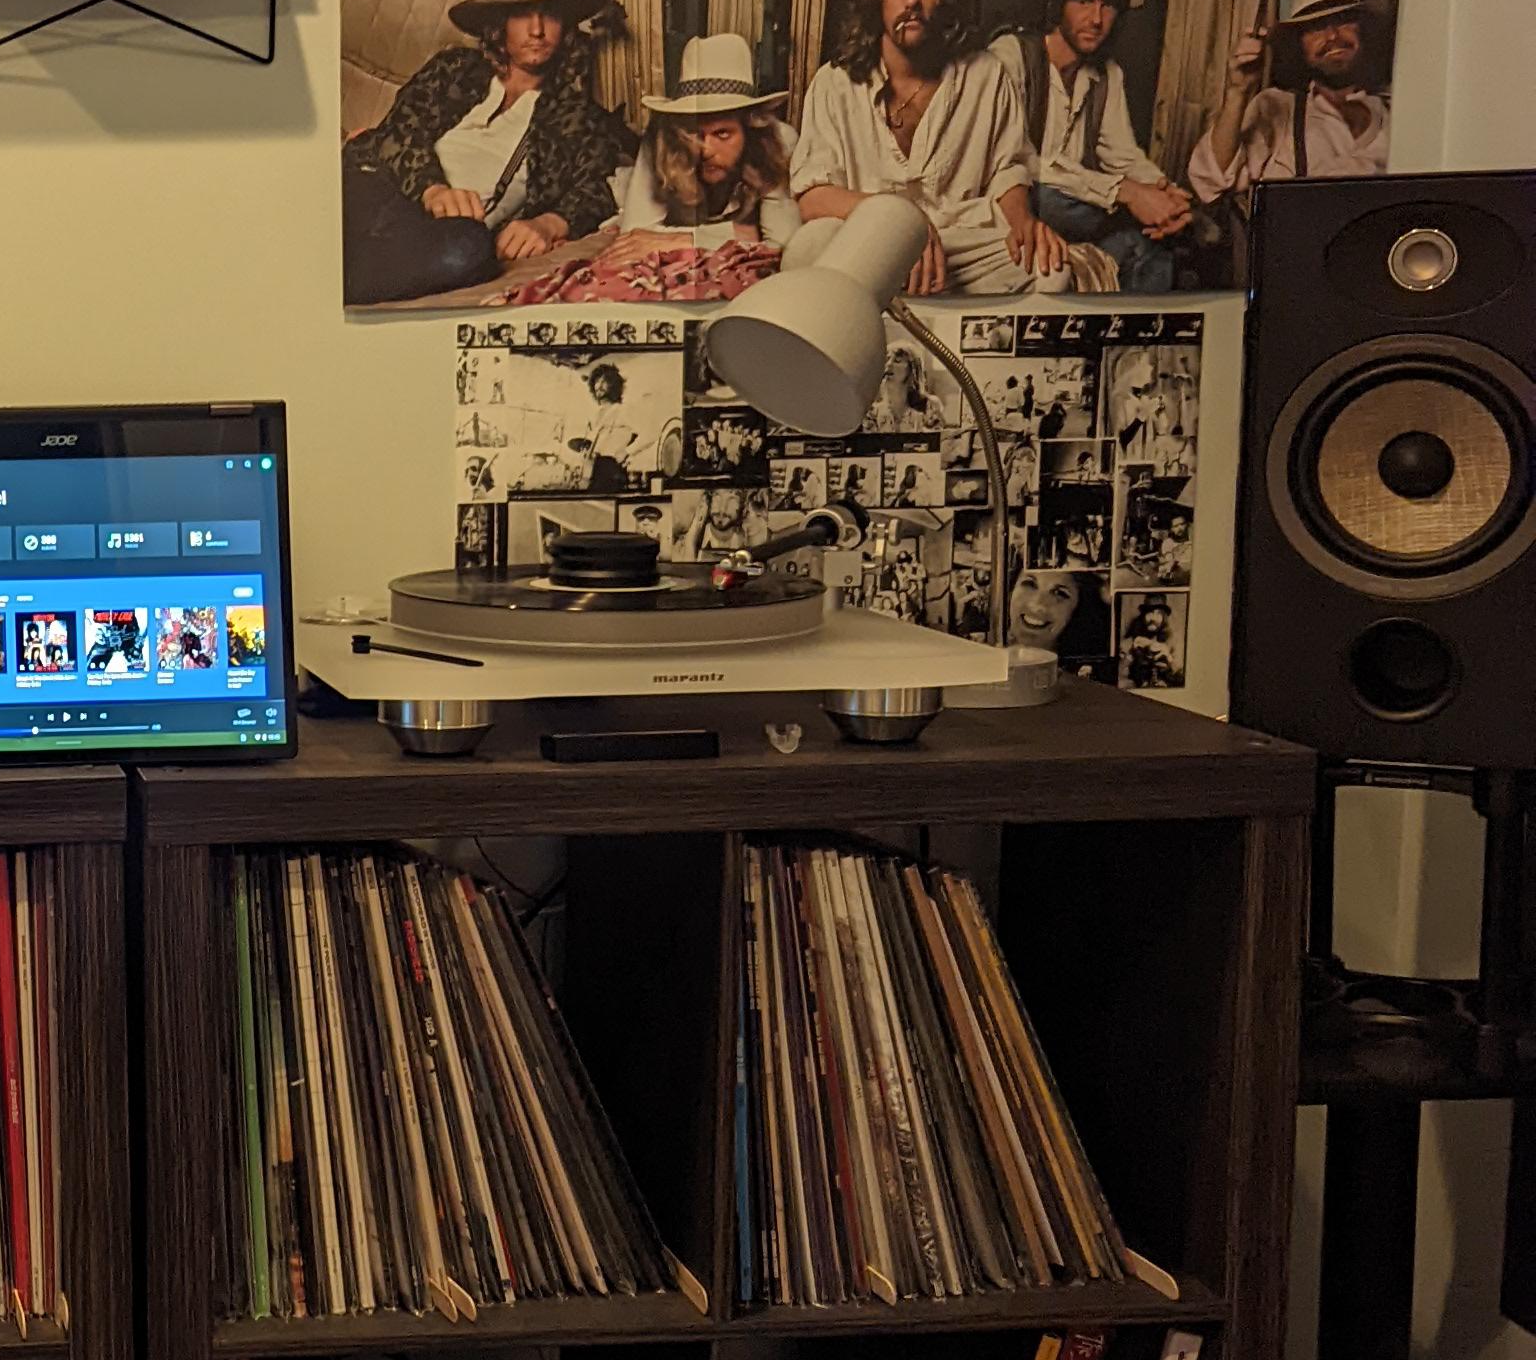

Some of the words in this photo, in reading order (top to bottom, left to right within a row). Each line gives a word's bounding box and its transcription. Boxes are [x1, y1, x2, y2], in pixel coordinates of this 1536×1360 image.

[41, 435, 78, 446] acer
[653, 673, 725, 683] marantz
[402, 918, 425, 983] RADIOHEAD
[423, 1016, 435, 1035] KID
[428, 1038, 438, 1047] A
[1075, 1334, 1104, 1357] The
